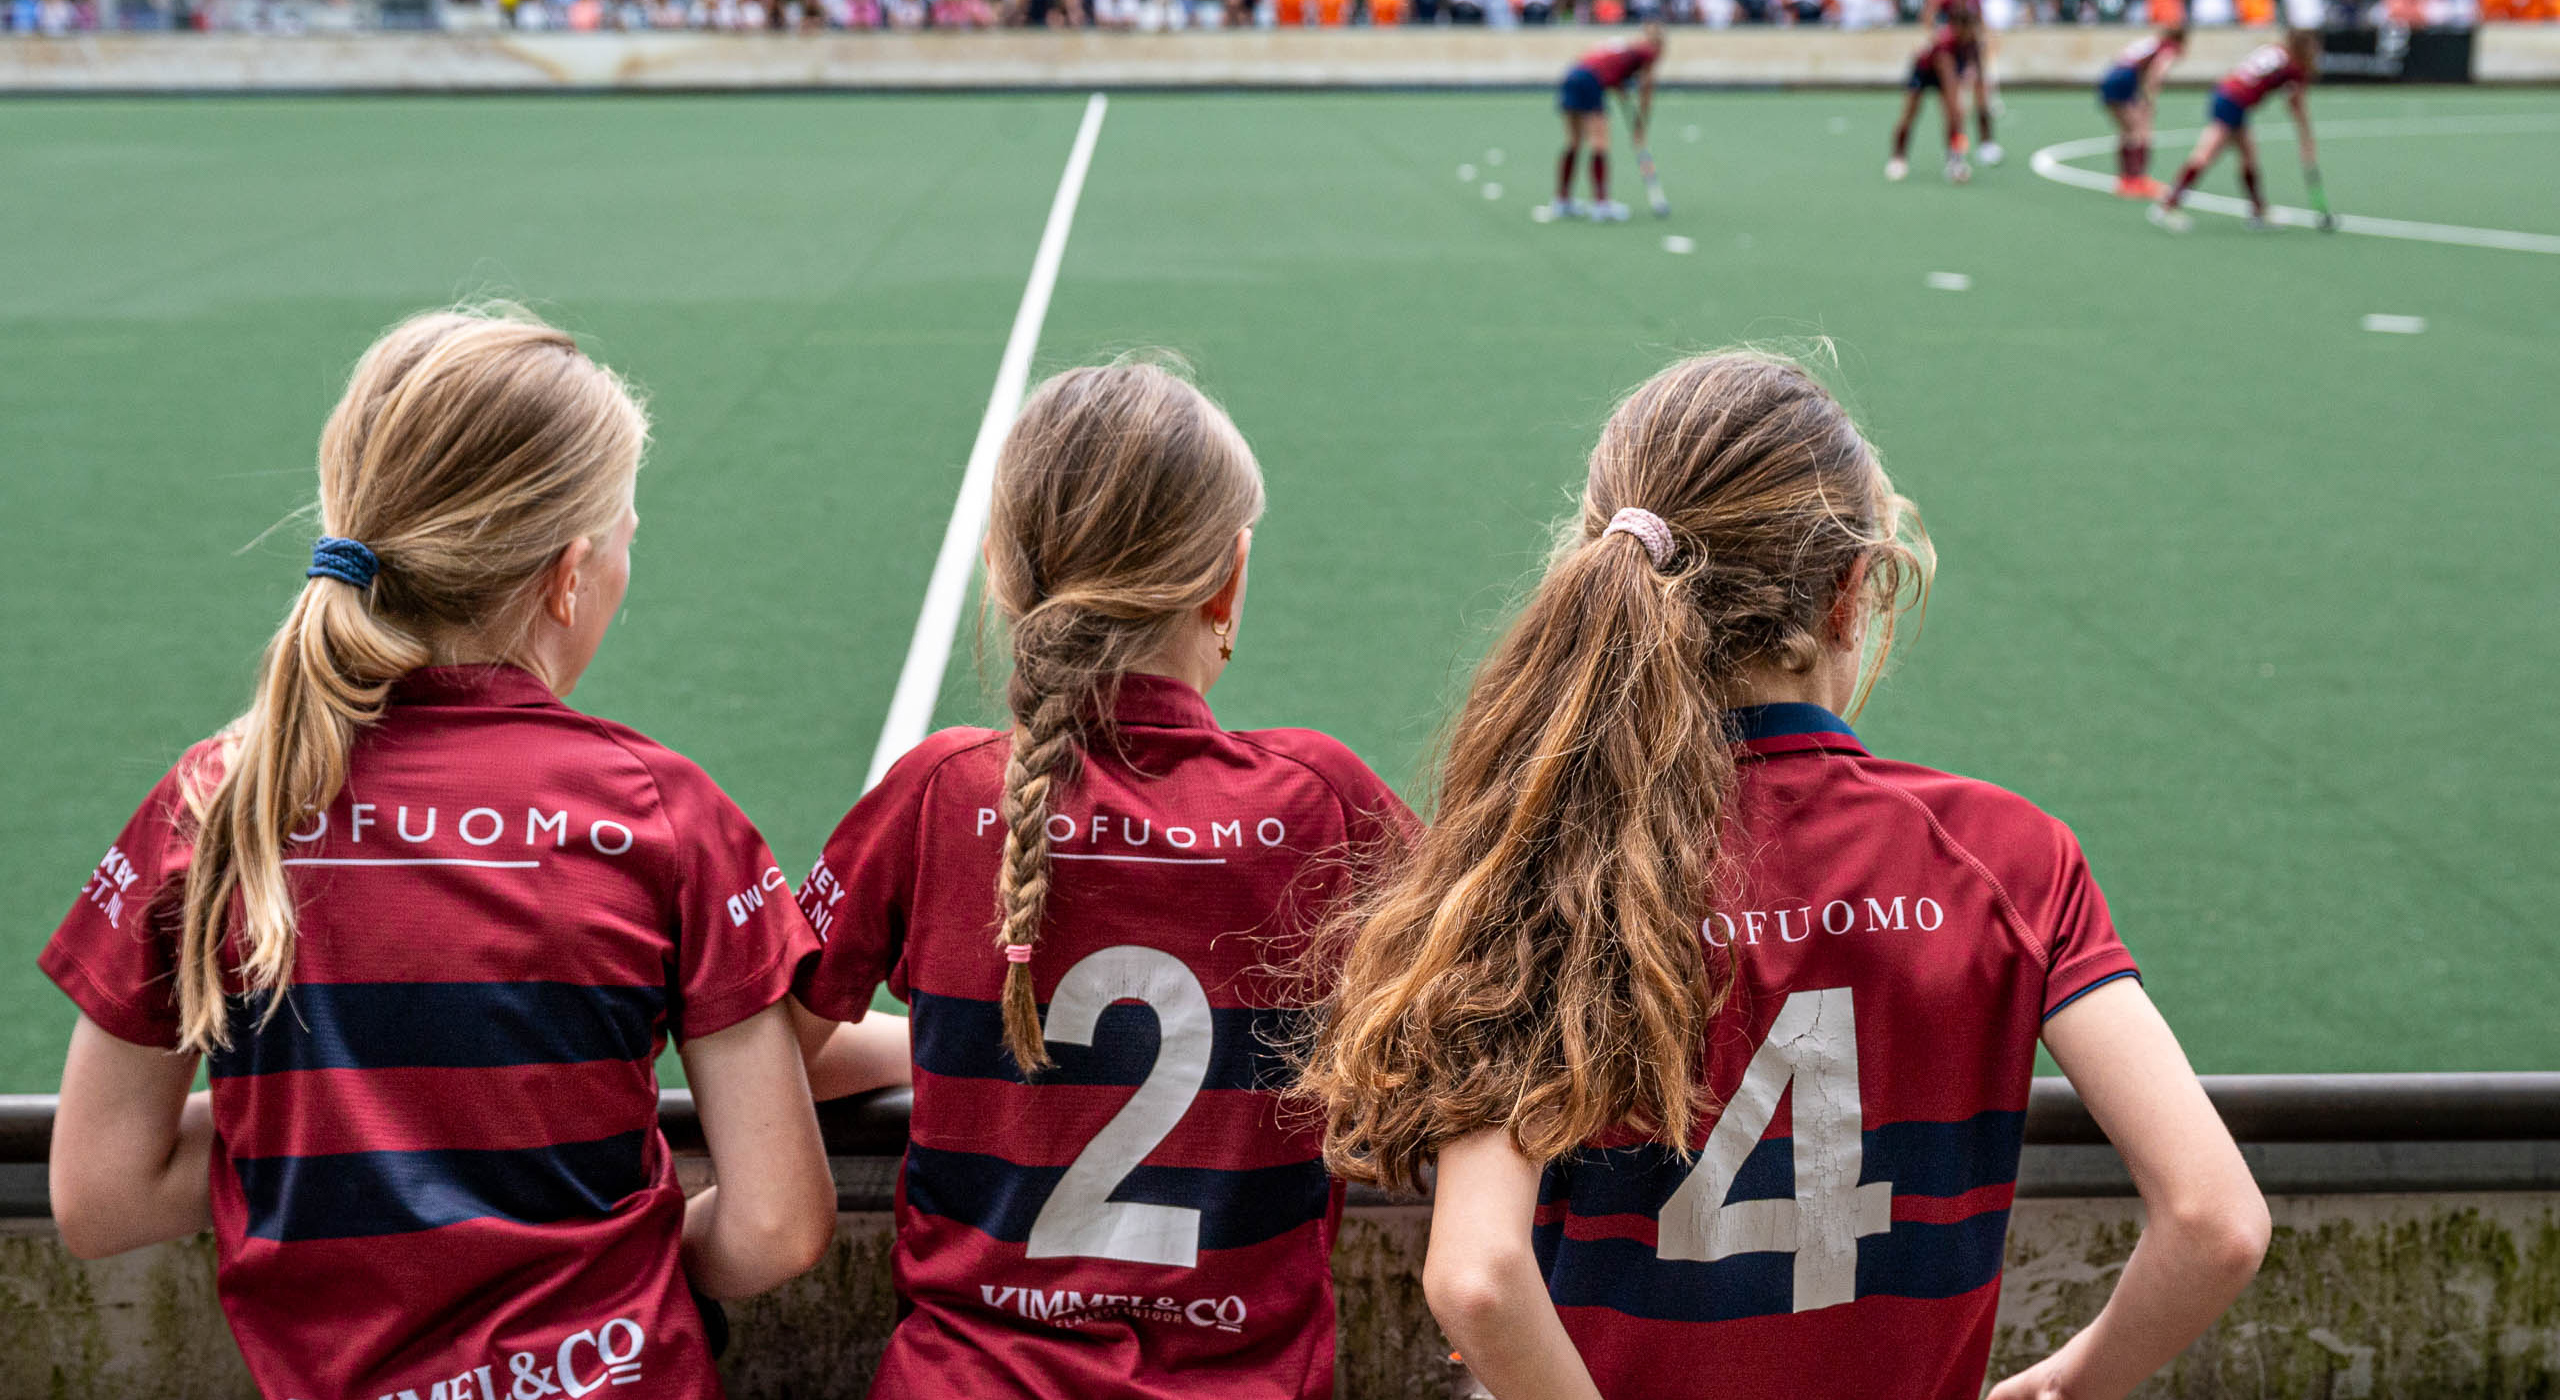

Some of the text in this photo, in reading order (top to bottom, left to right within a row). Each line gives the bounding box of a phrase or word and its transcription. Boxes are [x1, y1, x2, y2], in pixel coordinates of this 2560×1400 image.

[288, 803, 634, 855] OFUOMO
[976, 807, 1286, 849] POFUOMO
[1701, 896, 1944, 947] OFUOMO
[1025, 944, 1213, 1269] 2
[1656, 986, 1893, 1314] 4
